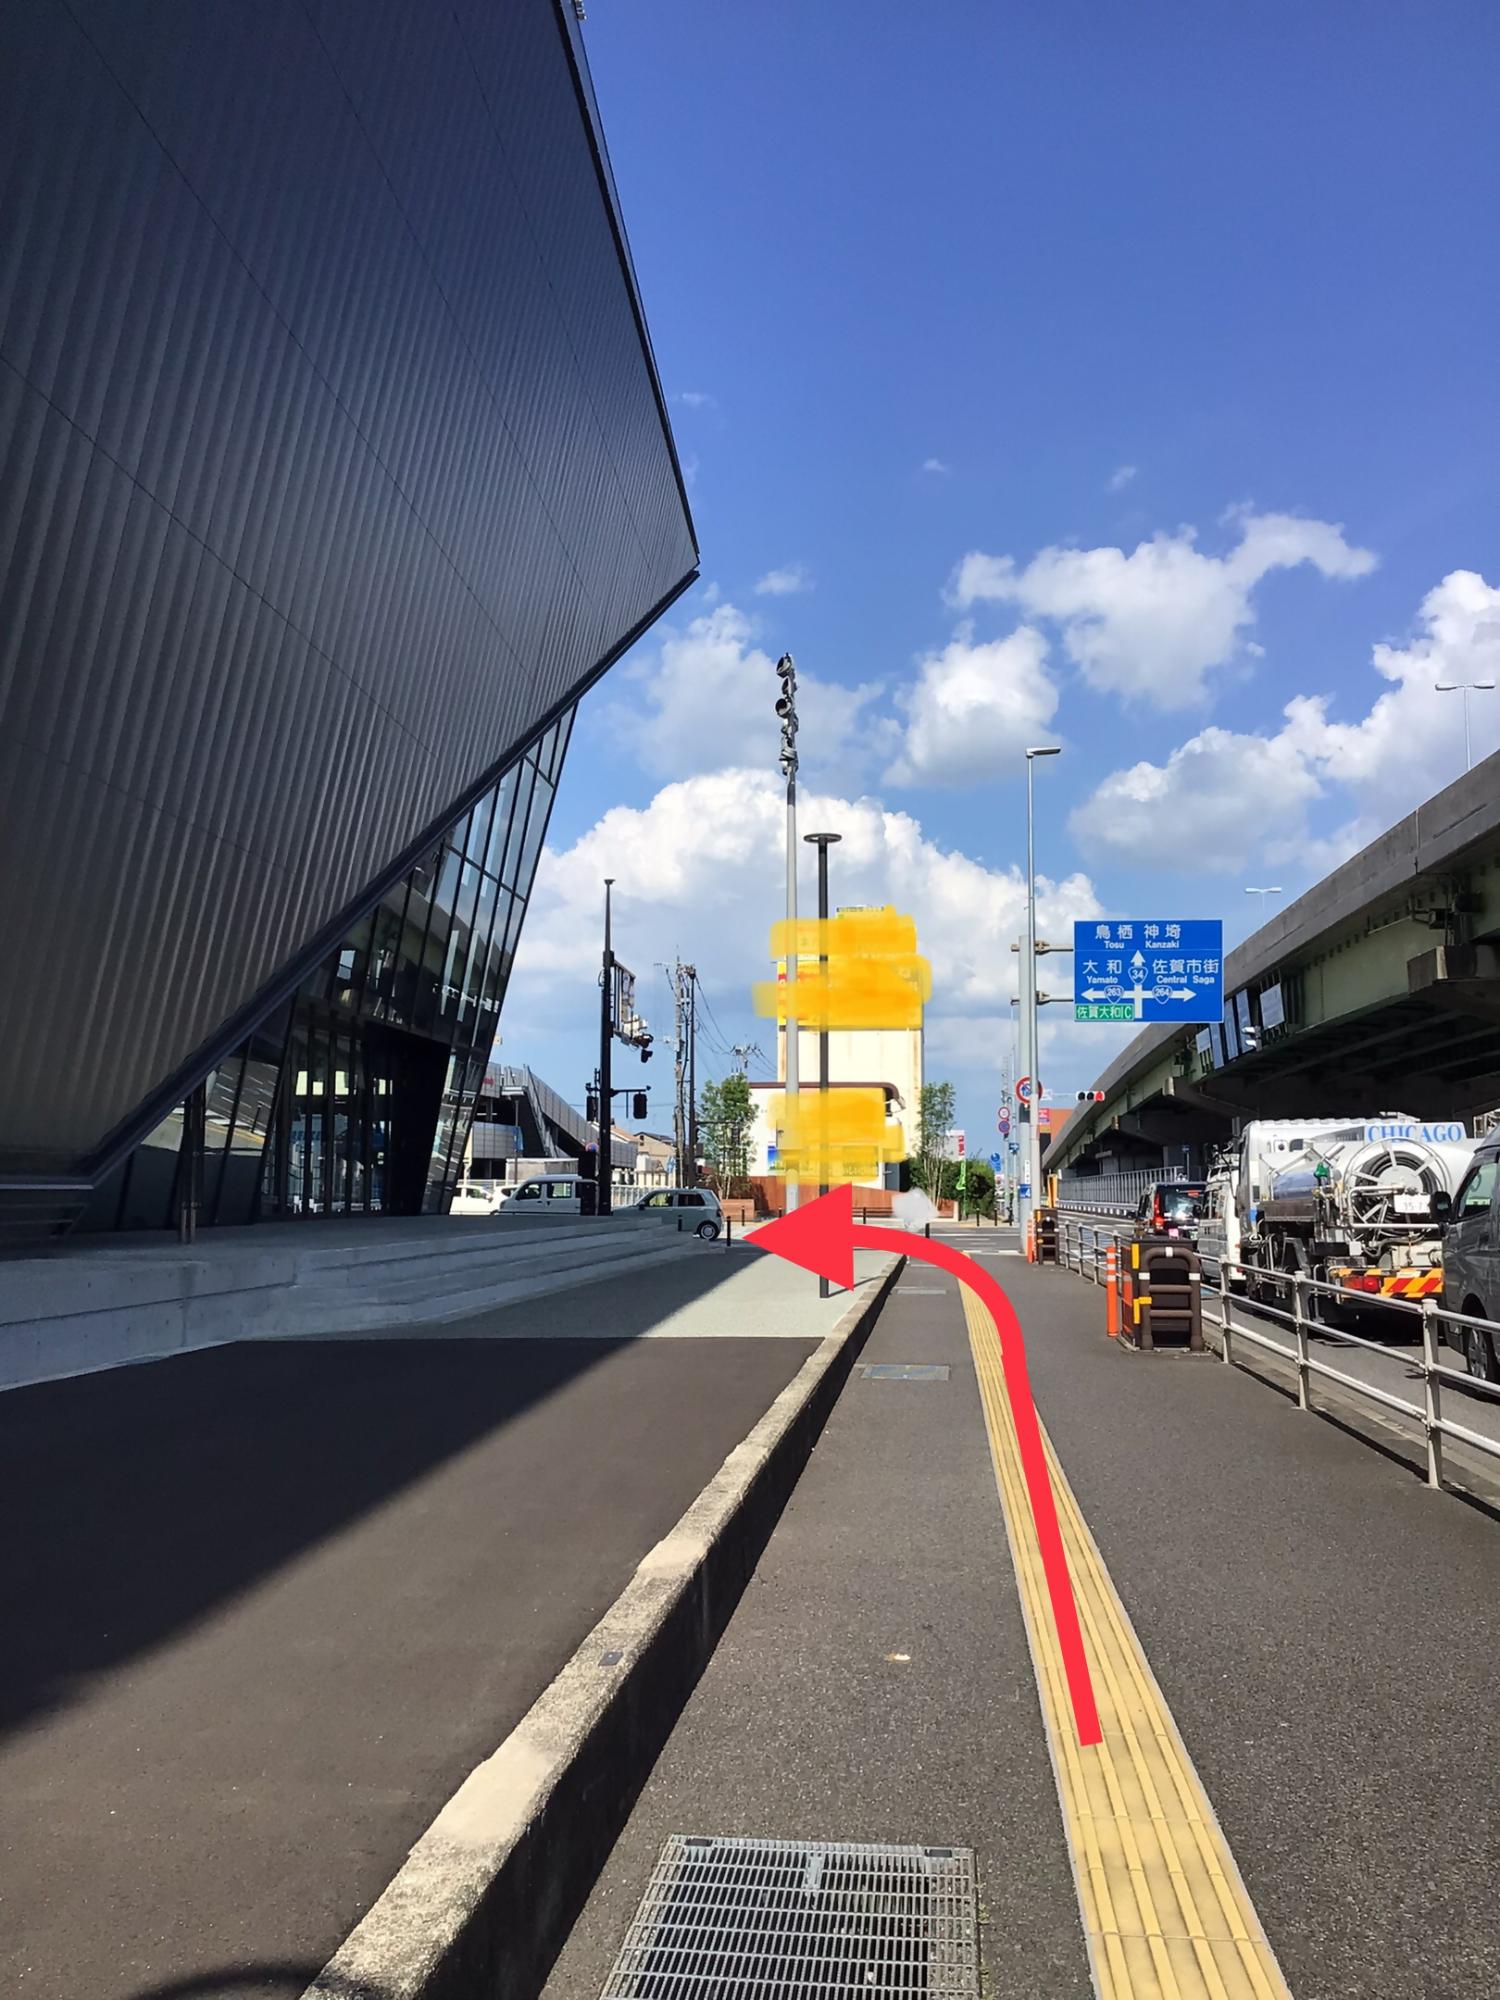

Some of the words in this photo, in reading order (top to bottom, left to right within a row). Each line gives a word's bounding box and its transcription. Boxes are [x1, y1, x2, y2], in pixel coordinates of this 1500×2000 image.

[1095, 924, 1133, 940] 鳥栖
[1104, 940, 1125, 949] Tosu
[1145, 940, 1180, 949] Kanzaki
[1082, 959, 1122, 974] 大和
[1152, 958, 1219, 974] 佐賀市街
[1086, 975, 1119, 984] Yamato
[1132, 969, 1144, 980] 34
[1156, 975, 1187, 984] Central
[1192, 975, 1215, 985] Saga
[1107, 988, 1122, 997] 263
[1155, 988, 1170, 997] 264
[1077, 1005, 1133, 1019] 佐賀大和IC
[1367, 1124, 1462, 1143] CHICAGO
